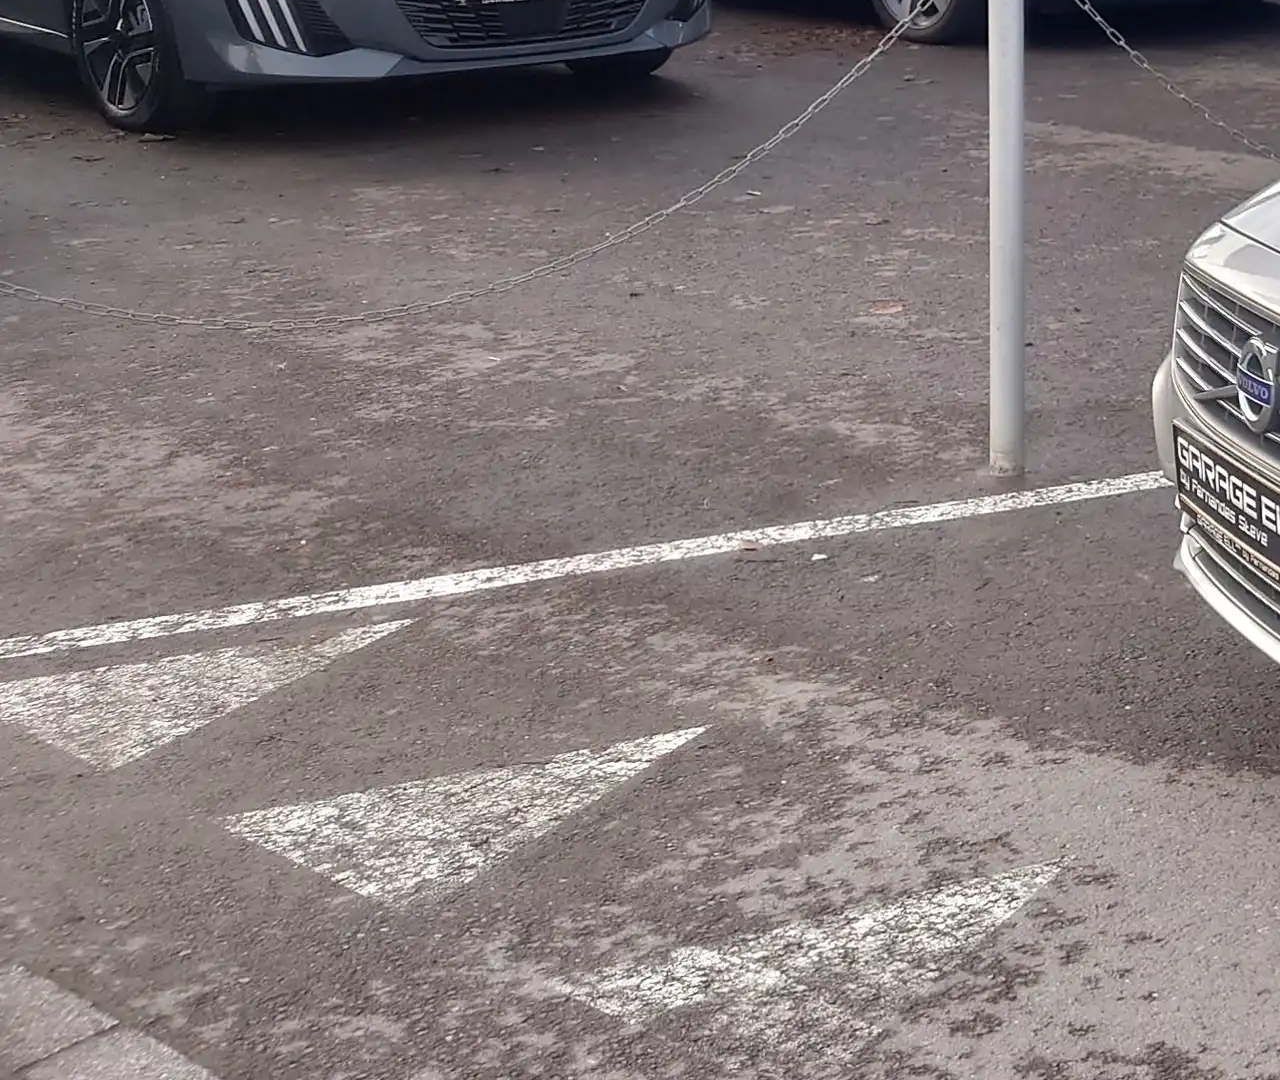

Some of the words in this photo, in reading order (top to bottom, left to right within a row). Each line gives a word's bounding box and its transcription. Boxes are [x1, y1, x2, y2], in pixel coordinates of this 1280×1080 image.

[1239, 373, 1269, 399] VOLVO
[1177, 436, 1258, 520] GARAGE
[1180, 470, 1191, 492] by
[1192, 478, 1236, 525] Fernandes
